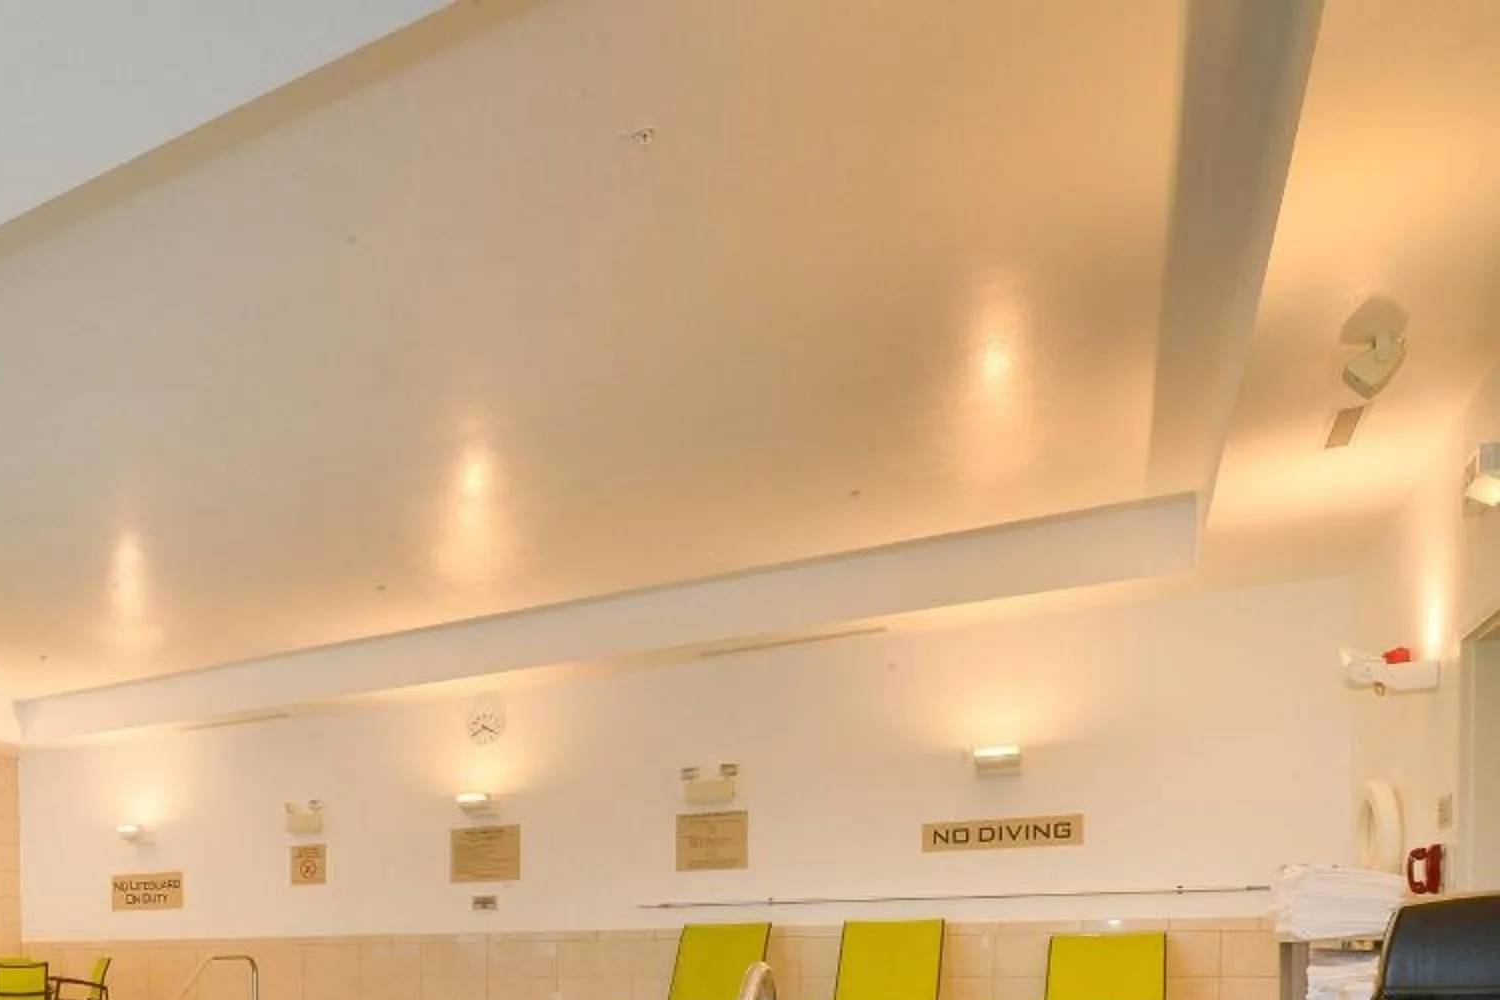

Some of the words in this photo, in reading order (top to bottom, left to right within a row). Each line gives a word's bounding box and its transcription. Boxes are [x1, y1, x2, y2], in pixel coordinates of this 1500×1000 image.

[933, 826, 970, 845] NO
[979, 821, 1072, 843] DIVING
[113, 880, 128, 892] NO
[125, 892, 140, 905] ON
